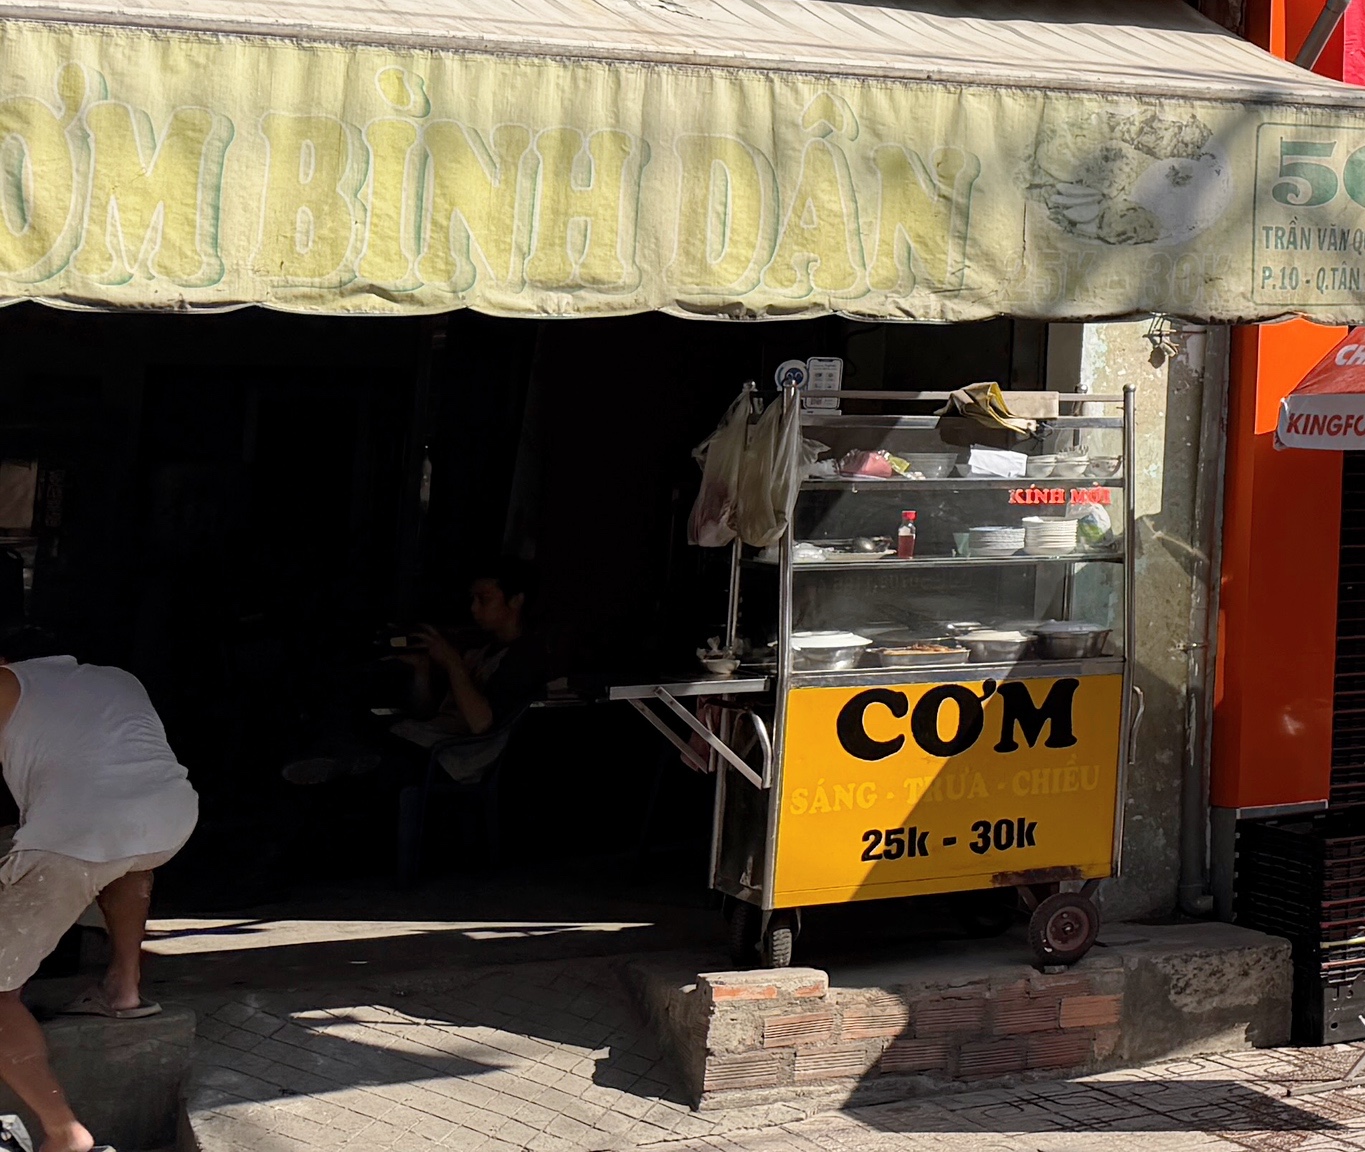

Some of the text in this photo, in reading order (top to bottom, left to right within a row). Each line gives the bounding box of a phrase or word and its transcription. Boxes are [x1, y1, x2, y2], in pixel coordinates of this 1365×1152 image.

[1261, 221, 1312, 252] TRẦN
[1316, 224, 1348, 253] VĂN
[1260, 265, 1299, 292] P.10
[836, 677, 1080, 762] CƠM
[789, 779, 878, 816] SÁNG
